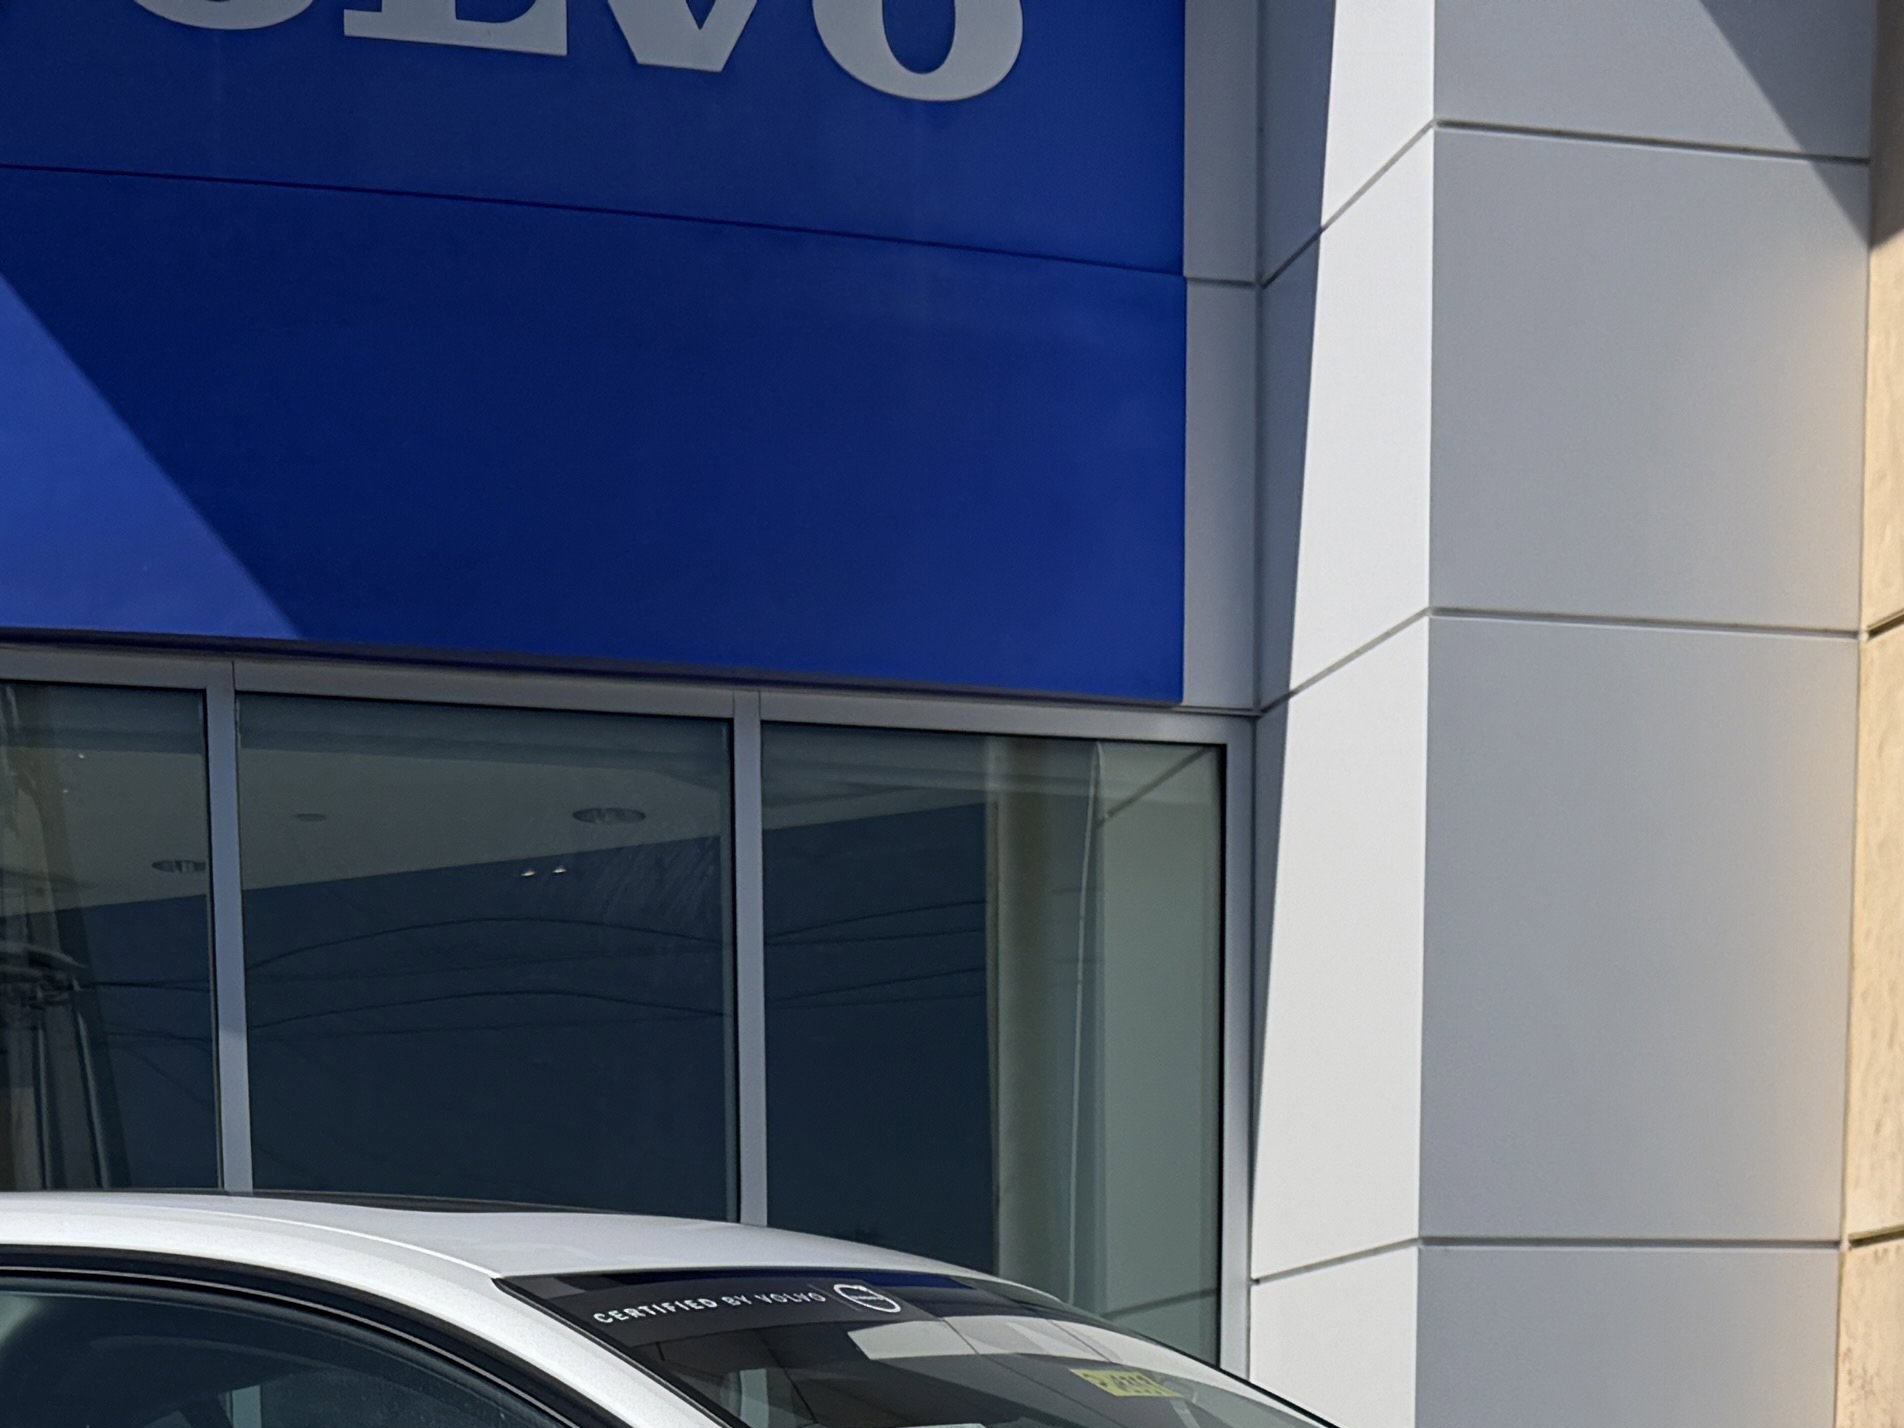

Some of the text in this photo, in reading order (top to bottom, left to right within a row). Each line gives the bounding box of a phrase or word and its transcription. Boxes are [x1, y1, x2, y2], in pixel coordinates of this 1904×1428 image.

[593, 1291, 827, 1324] CERTIFIED BY VOLVO
